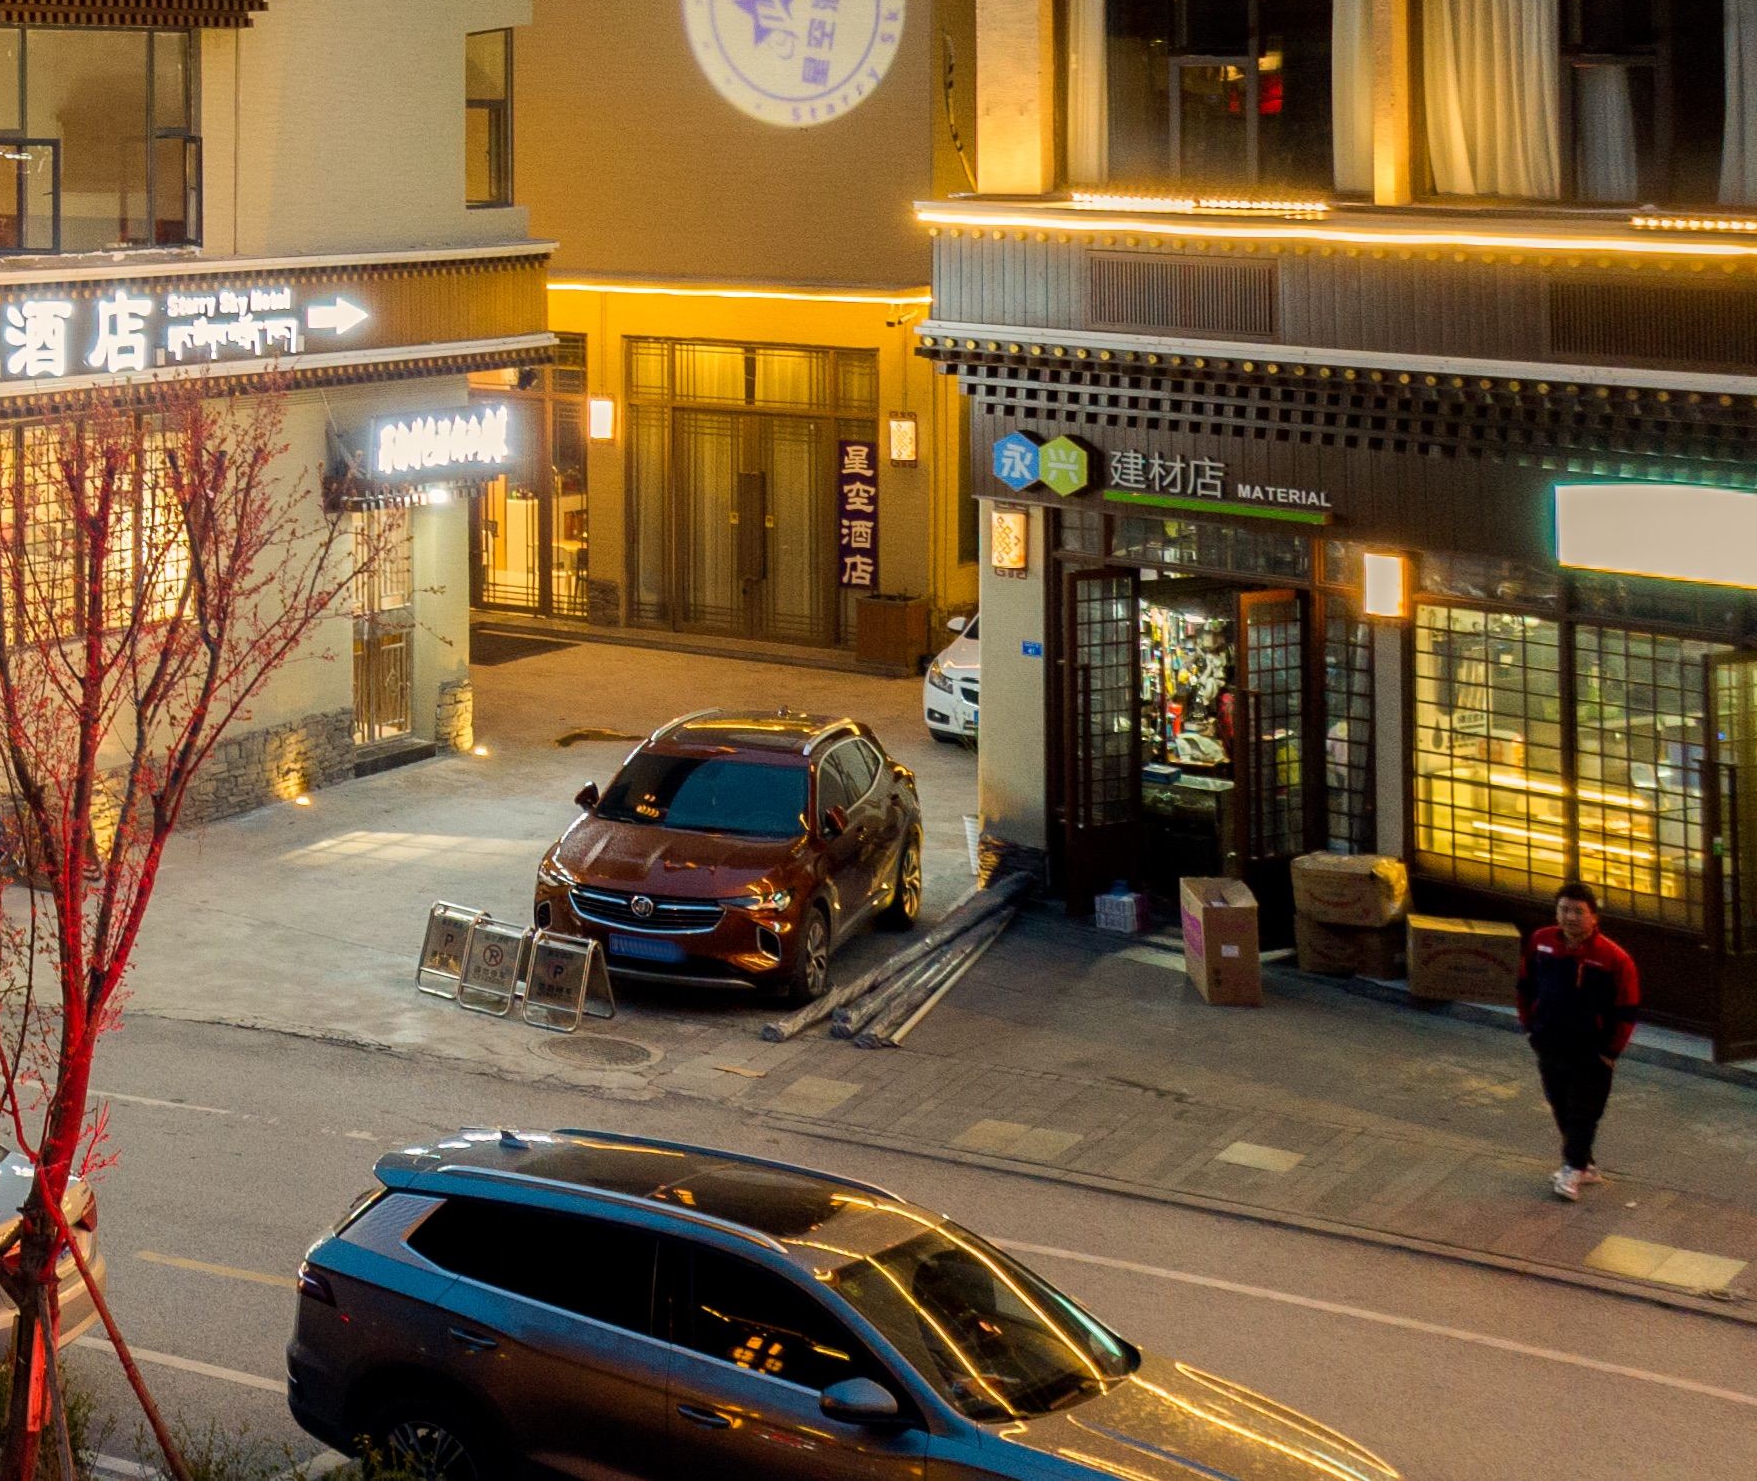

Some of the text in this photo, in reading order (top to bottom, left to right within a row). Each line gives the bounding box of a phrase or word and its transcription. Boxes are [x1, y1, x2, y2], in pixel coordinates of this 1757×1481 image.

[841, 445, 875, 586] 星空酒店
[1001, 443, 1332, 508] 永兴 建材店 MATERIAL
